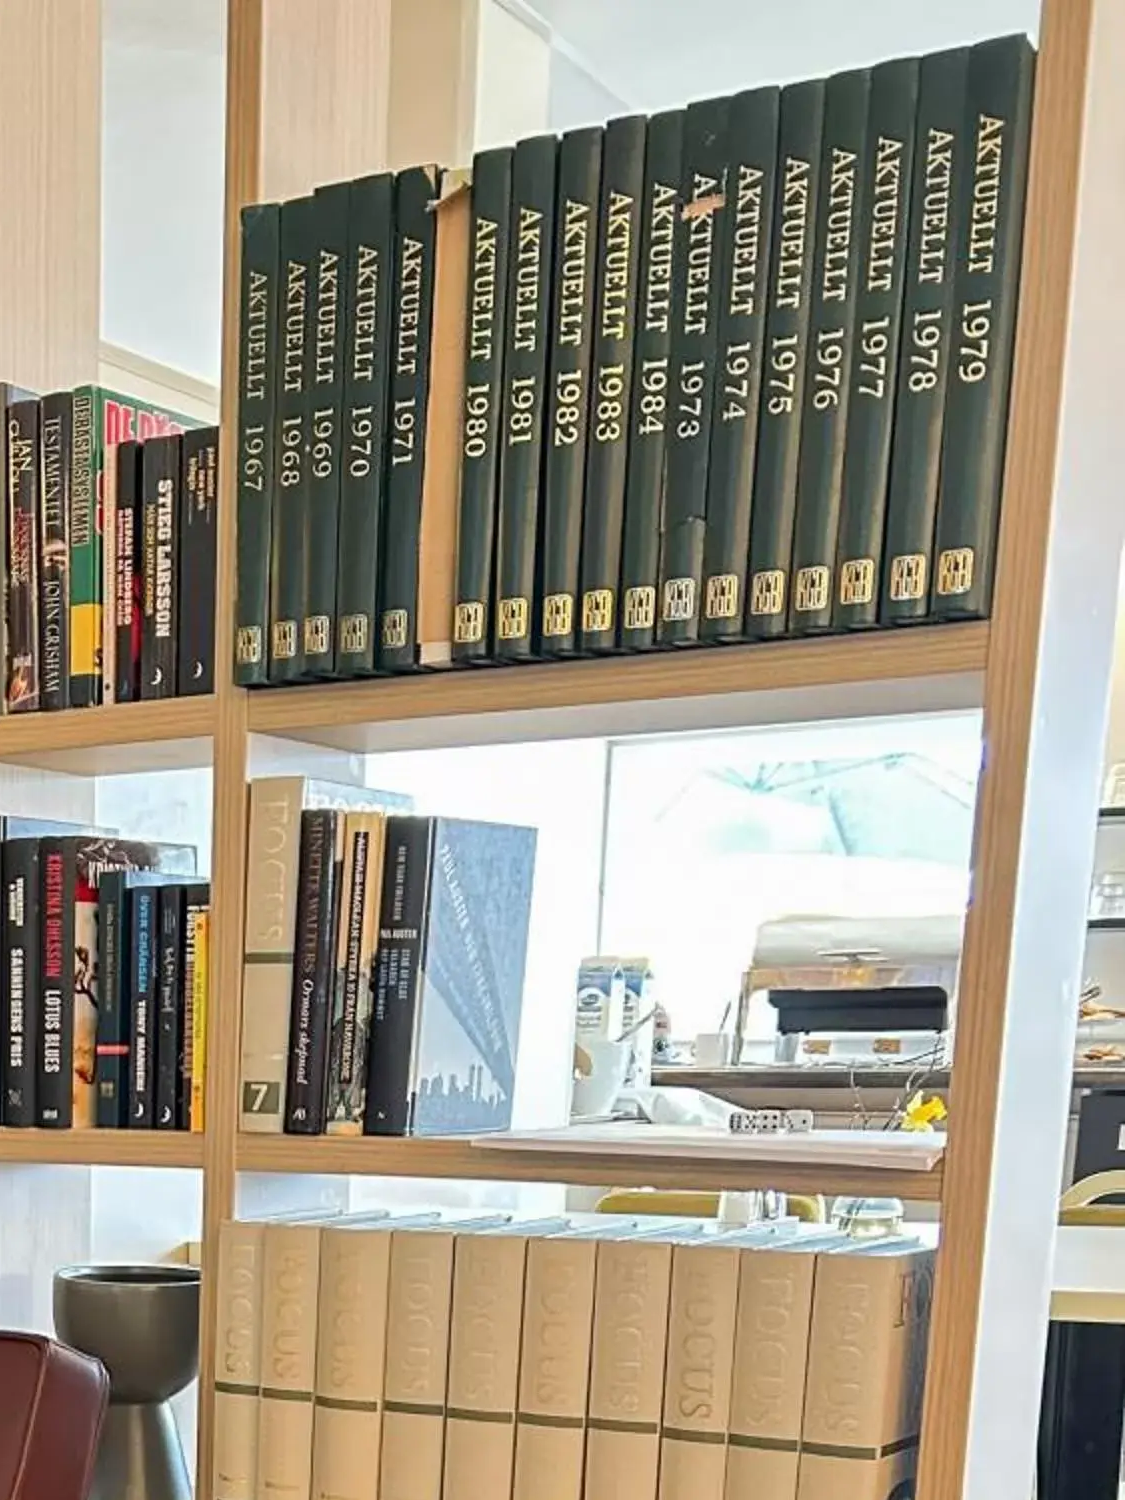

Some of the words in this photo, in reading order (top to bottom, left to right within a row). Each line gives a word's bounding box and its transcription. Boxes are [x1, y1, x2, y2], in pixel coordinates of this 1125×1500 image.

[776, 157, 811, 309] AKTUELLT
[822, 147, 857, 302] AKTUELLT
[868, 136, 903, 291] AKTUELLT
[919, 127, 954, 284] AKTUELLT
[968, 113, 1005, 273] AKTUELLT
[514, 207, 543, 352] AKTUELLT
[561, 199, 590, 346] AKTUELLT
[602, 191, 634, 341] AKTUELLT
[646, 183, 677, 334] AKTUELLT
[684, 173, 717, 335] AKTUELLT
[730, 165, 764, 315] AKTUELLT
[284, 260, 307, 392] AKTUELLT
[316, 250, 339, 383] AKTUELLT
[354, 245, 378, 381] AKTUELLT
[397, 236, 424, 375] AKTUELLT
[471, 217, 499, 360] AKTUELLT
[246, 271, 268, 400] AKTUELLT
[768, 334, 798, 415] 1975
[813, 328, 845, 410] 1976
[858, 316, 890, 399] 1977
[908, 309, 942, 393] 1978
[959, 300, 992, 383] 1979
[465, 383, 490, 457] 1980
[509, 376, 536, 445] 1981
[554, 369, 582, 447] 1982
[596, 364, 624, 442] 1983
[639, 358, 668, 435] 1984
[676, 361, 705, 438] 1973
[722, 341, 751, 421] 1974
[18, 439, 33, 472] JAN
[44, 414, 62, 527] TESTAMENTET
[244, 424, 264, 492] 1967
[280, 415, 302, 487] 1968
[312, 408, 334, 477] 1969
[349, 405, 372, 477] 1970
[391, 397, 416, 466] 1971
[123, 506, 133, 556] STEFAN
[157, 478, 173, 540] STIEG
[43, 579, 59, 620] JOHN
[122, 558, 133, 626] LINDBERG
[155, 544, 172, 638] LARSSON
[42, 622, 59, 692] GRISHAM
[46, 853, 63, 915] KRISTINA
[260, 792, 290, 942] FOCUS
[309, 814, 324, 895] MINETTE
[45, 917, 62, 977] OHLSSON
[302, 896, 320, 974] WALTERS
[10, 947, 24, 1032] SANNINGENS
[44, 988, 62, 1031] LOTUS
[9, 1034, 23, 1067] PRIS
[43, 1032, 61, 1073] BLUES
[250, 1084, 268, 1110] 7
